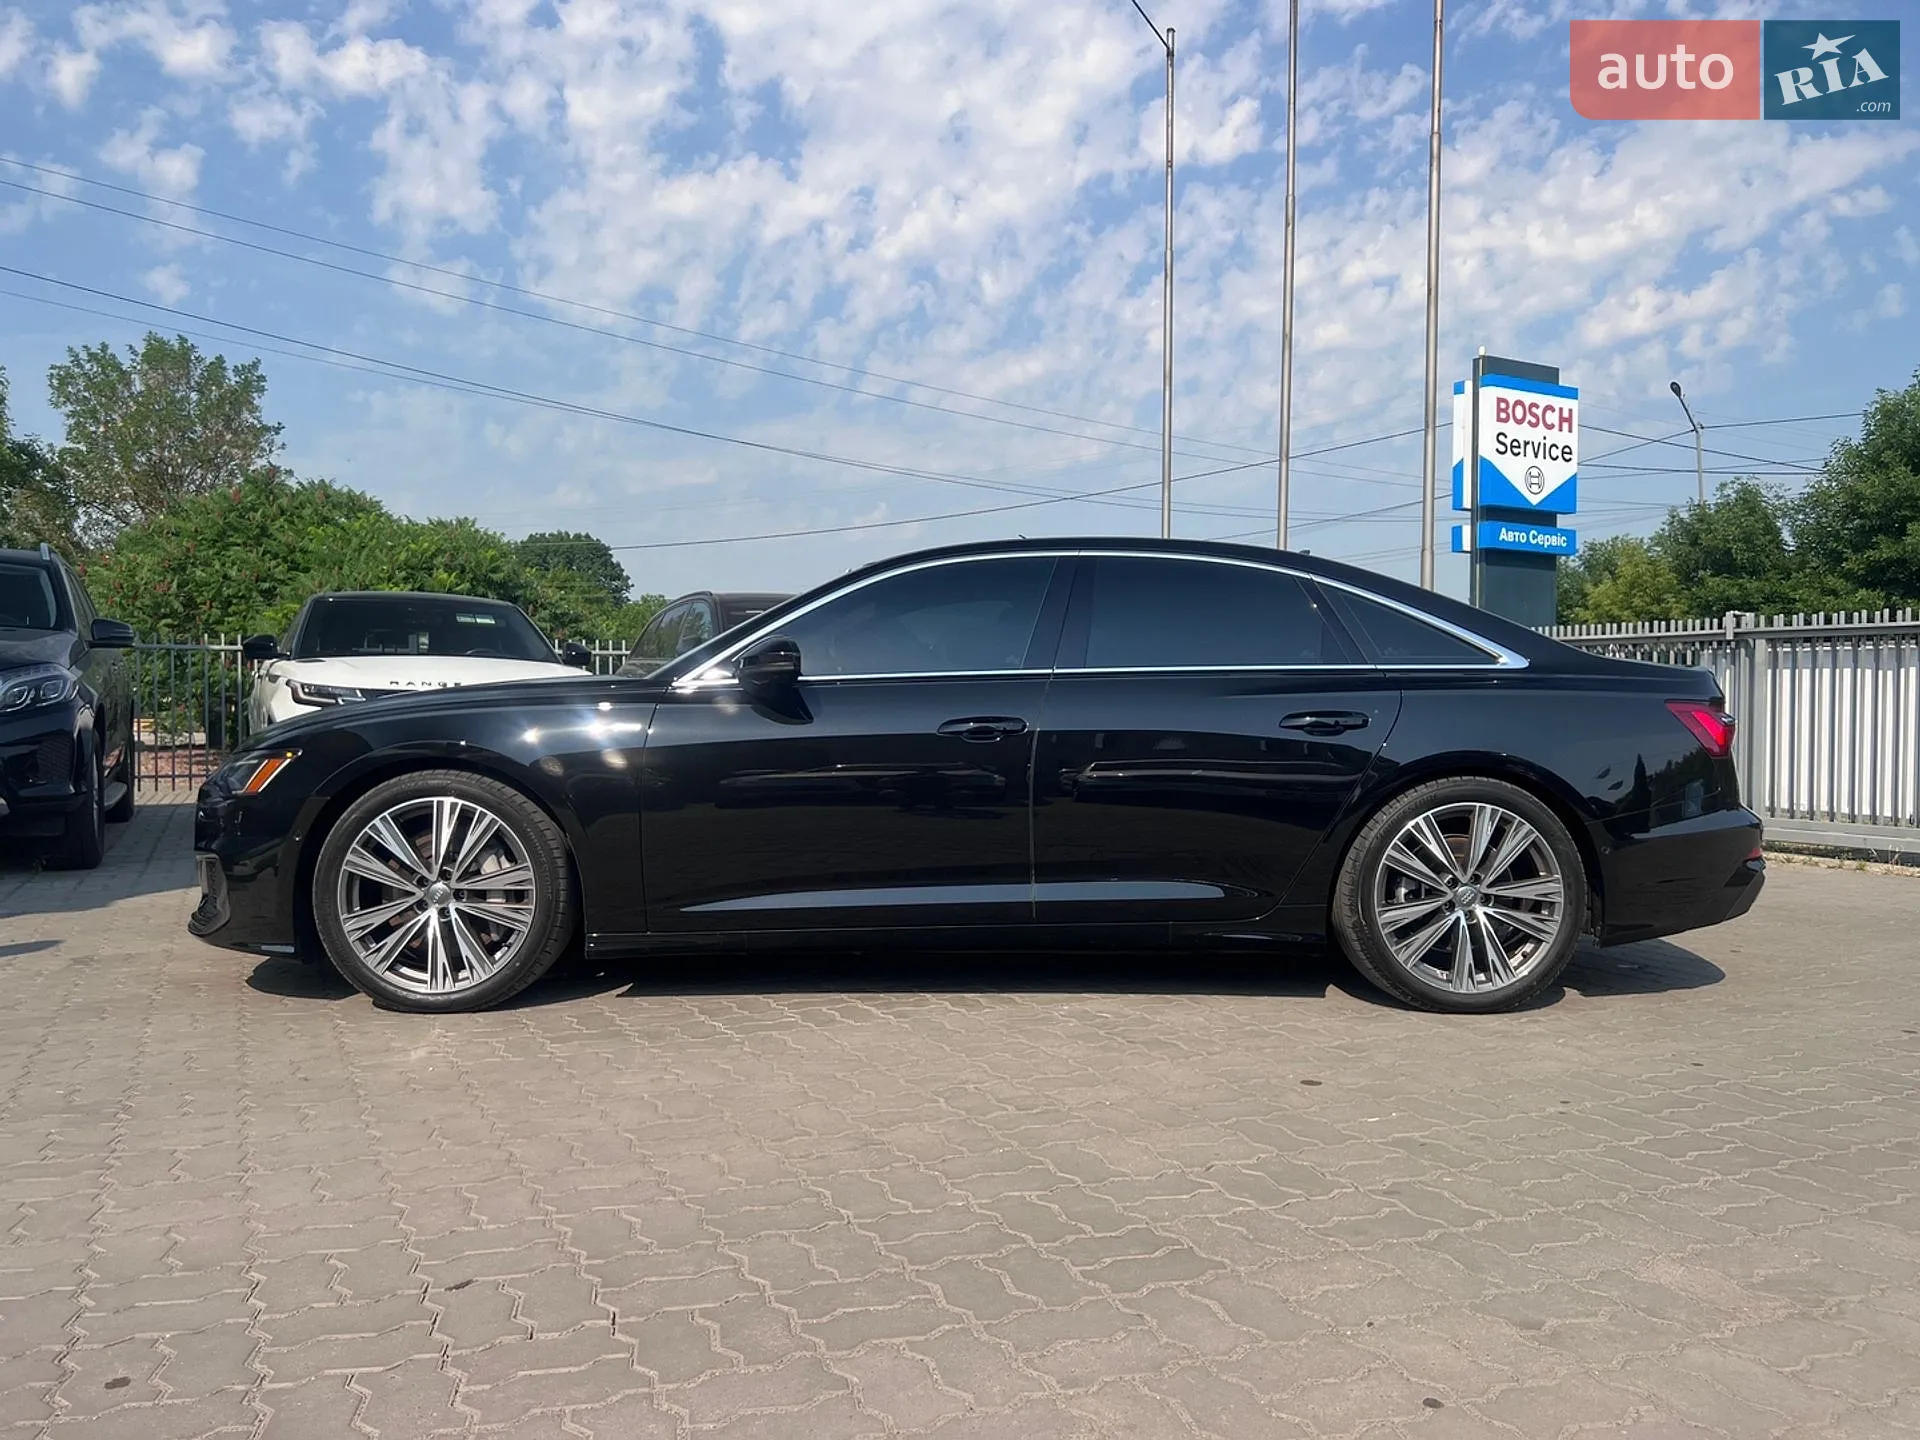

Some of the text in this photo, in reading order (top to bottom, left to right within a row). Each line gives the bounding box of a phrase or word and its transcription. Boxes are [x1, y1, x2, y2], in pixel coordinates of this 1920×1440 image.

[1496, 397, 1573, 433] BOSCH
[1495, 432, 1573, 463] Service
[1499, 527, 1567, 548] Авто Сервіс
